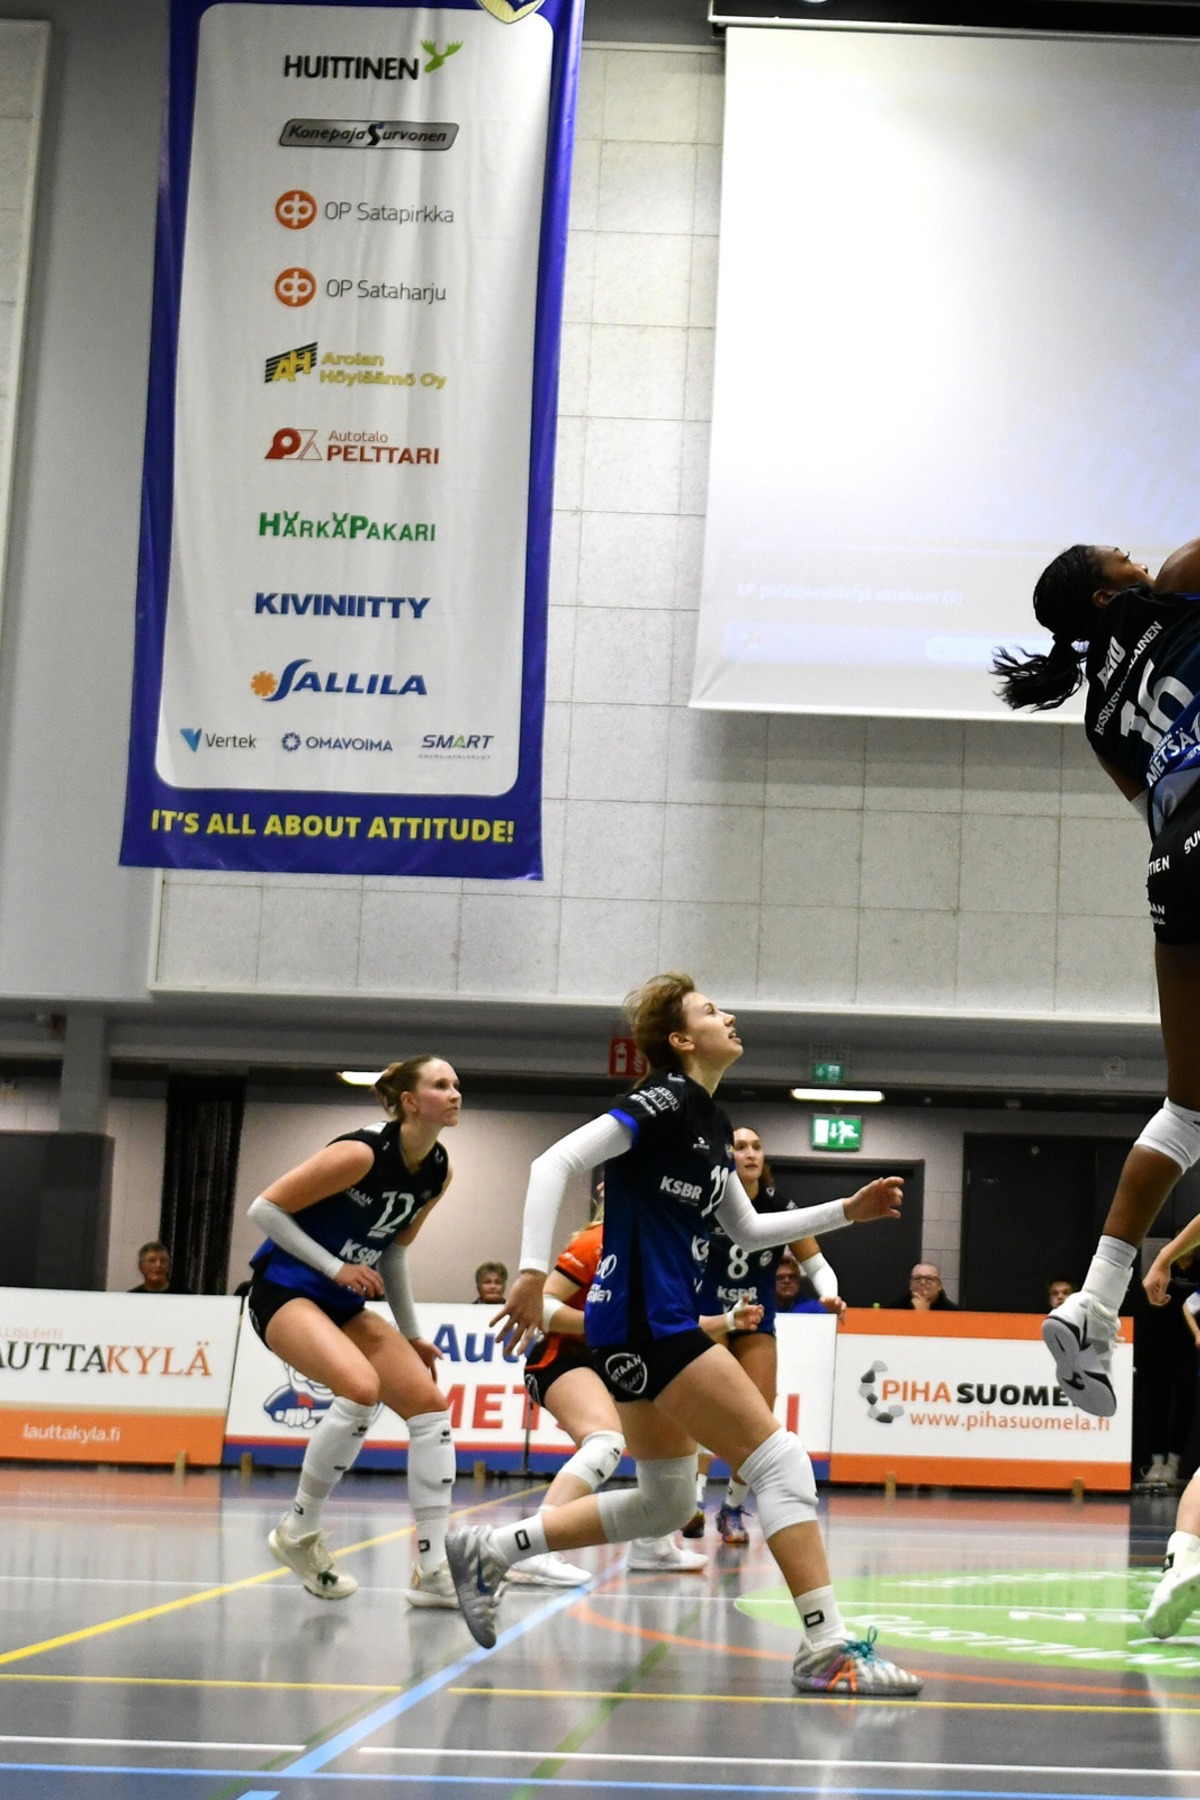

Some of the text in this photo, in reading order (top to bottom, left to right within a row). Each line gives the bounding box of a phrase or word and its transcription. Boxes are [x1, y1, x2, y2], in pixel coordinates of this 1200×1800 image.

[283, 54, 420, 81] HUITTINEN
[325, 201, 455, 225] OP Satapirkka
[326, 279, 447, 304] OP Sataharju
[420, 372, 447, 389] Oy
[329, 429, 389, 443] Autotalo
[327, 444, 440, 465] PELTTARI
[254, 592, 431, 619] KIVINIITTY
[260, 658, 428, 702] SALLILA
[206, 733, 257, 749] Vertek
[305, 736, 393, 752] OMAVOIMA
[421, 734, 495, 749] SMART
[151, 808, 515, 843] IT'S ALL ABOUT ATTITUDE!
[660, 1175, 703, 1200] KSBR
[728, 1243, 750, 1280] 8
[881, 1379, 1077, 1407] PIHA SUOME
[23, 1422, 121, 1445] lauttakyla.fi
[909, 1411, 1111, 1432] www.pihasuomela.fi
